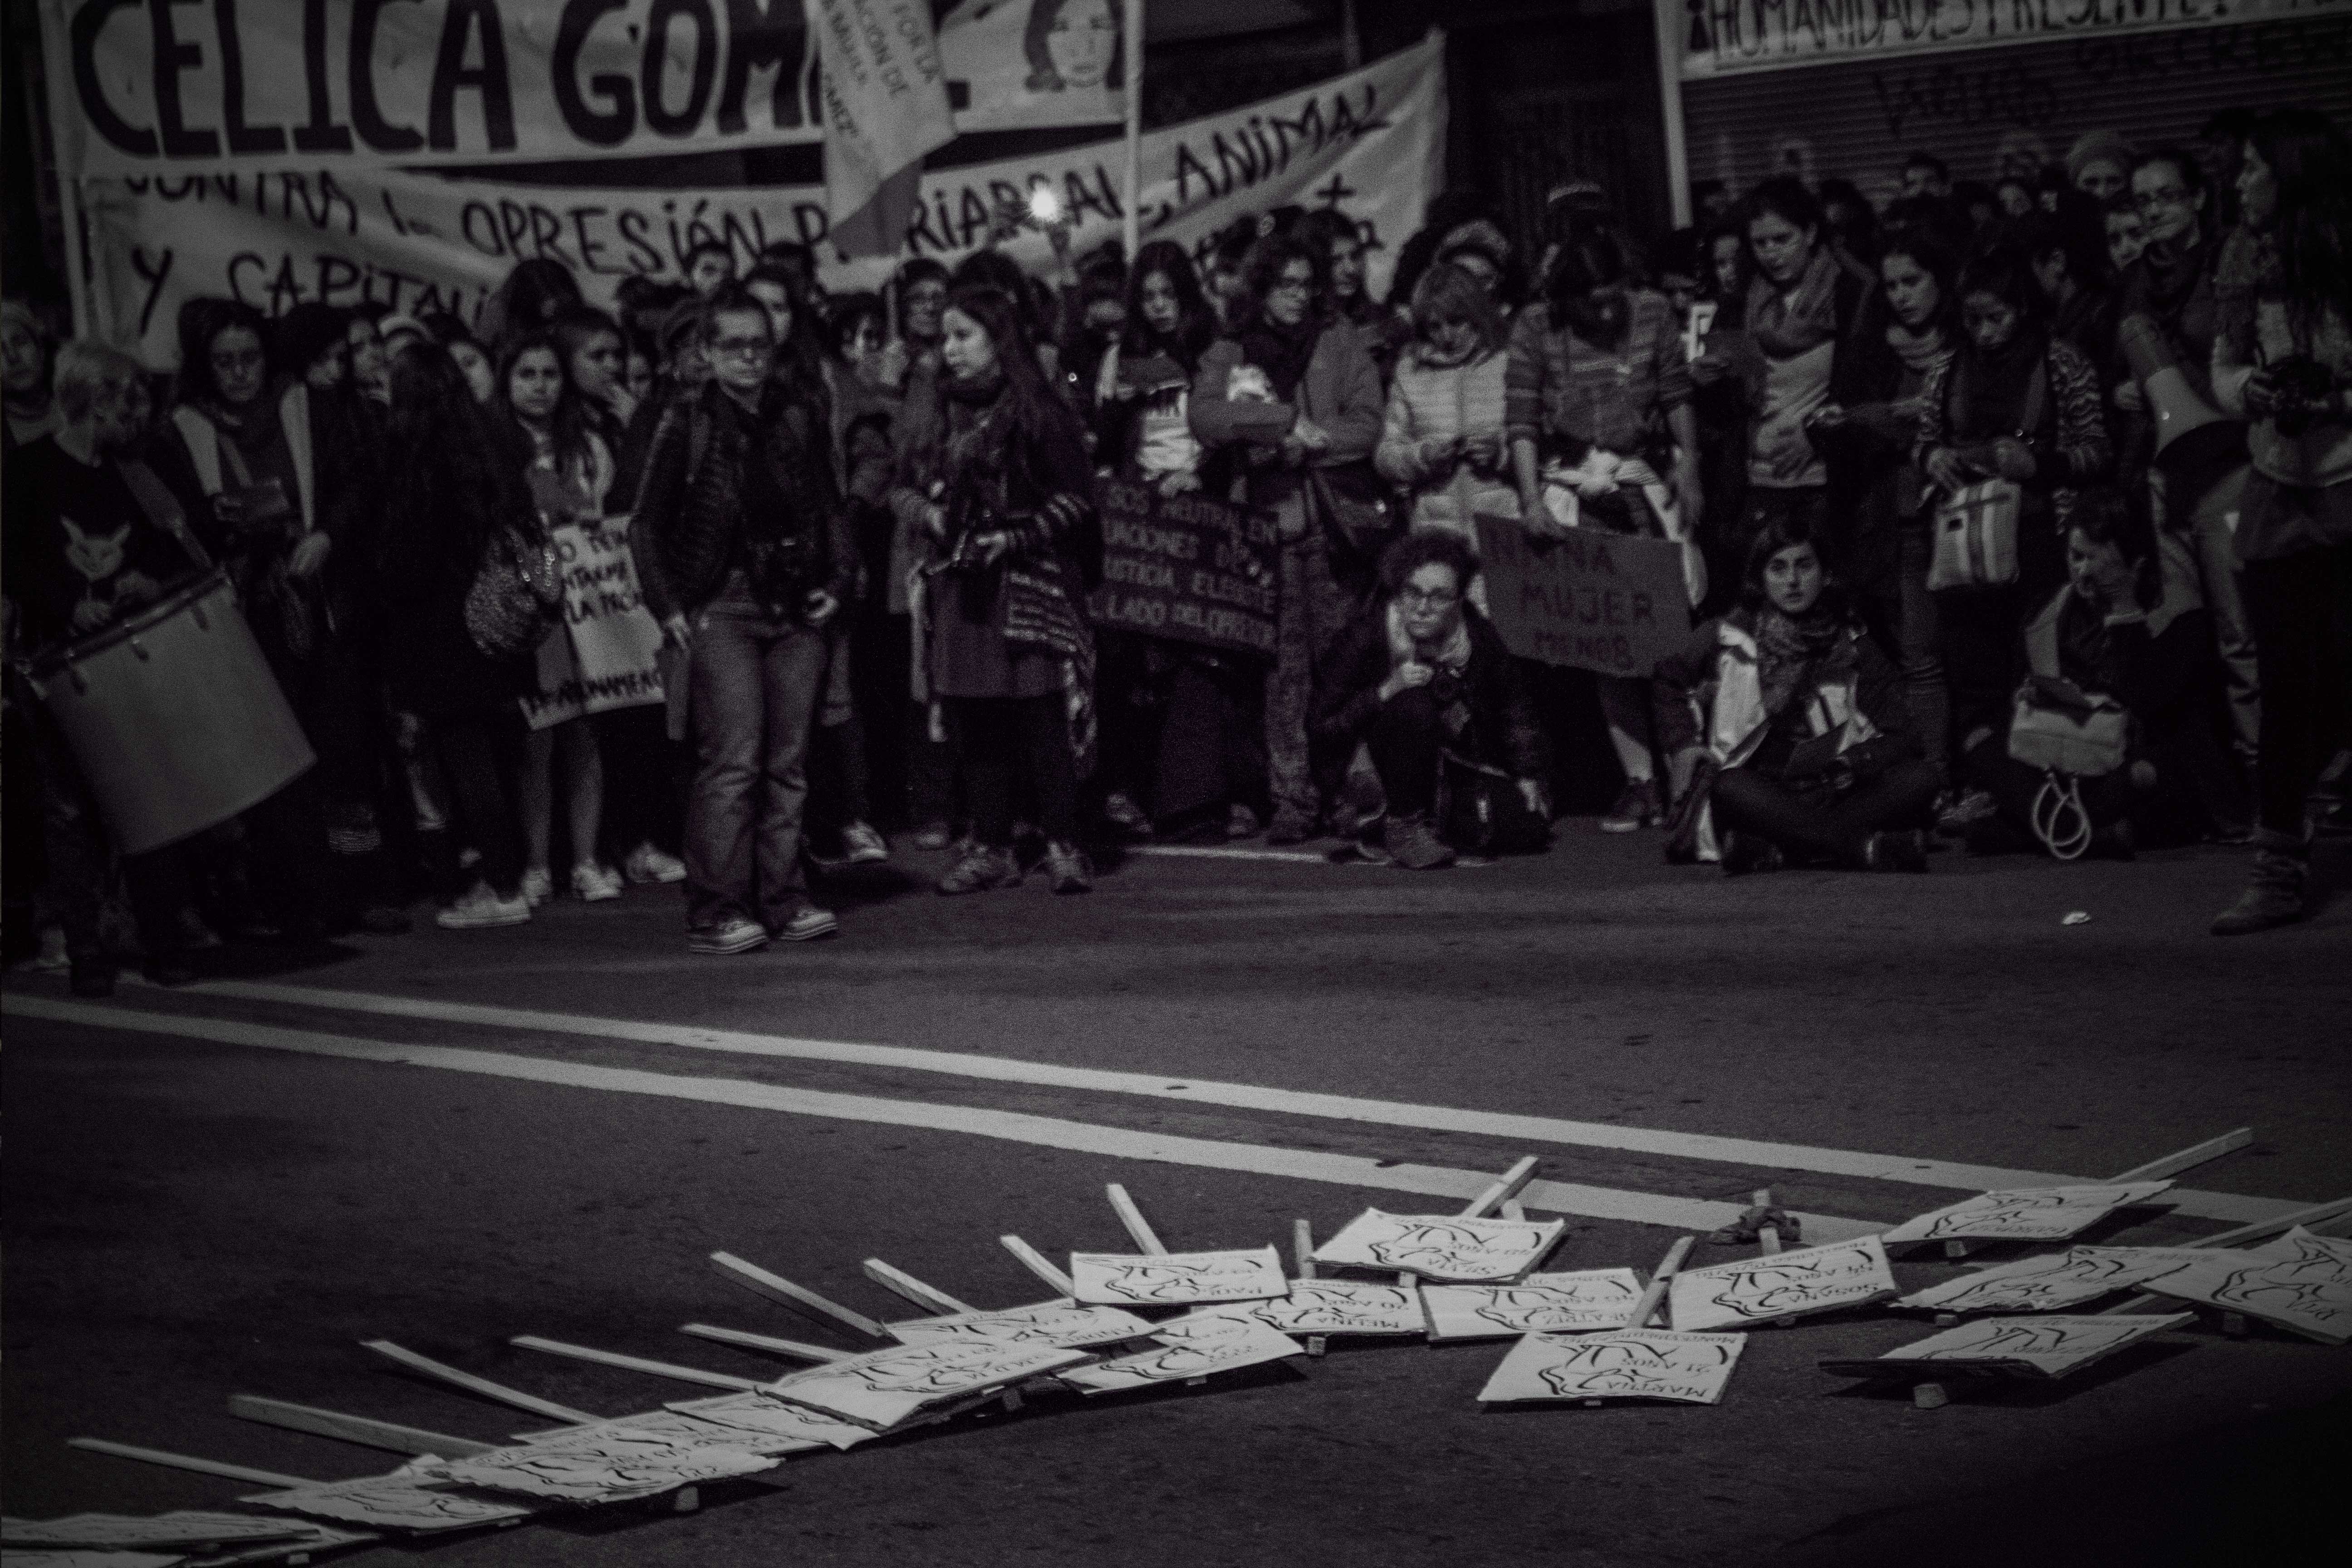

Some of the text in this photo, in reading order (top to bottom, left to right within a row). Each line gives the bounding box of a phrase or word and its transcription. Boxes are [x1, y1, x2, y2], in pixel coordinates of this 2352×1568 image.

[72, 0, 516, 157] CELICA
[552, 0, 821, 146] GOM
[132, 249, 172, 335] Y
[1518, 581, 1658, 630] MUJER
[1317, 1317, 1399, 1329] MELINA
[1607, 1381, 1709, 1397] MARTHA
